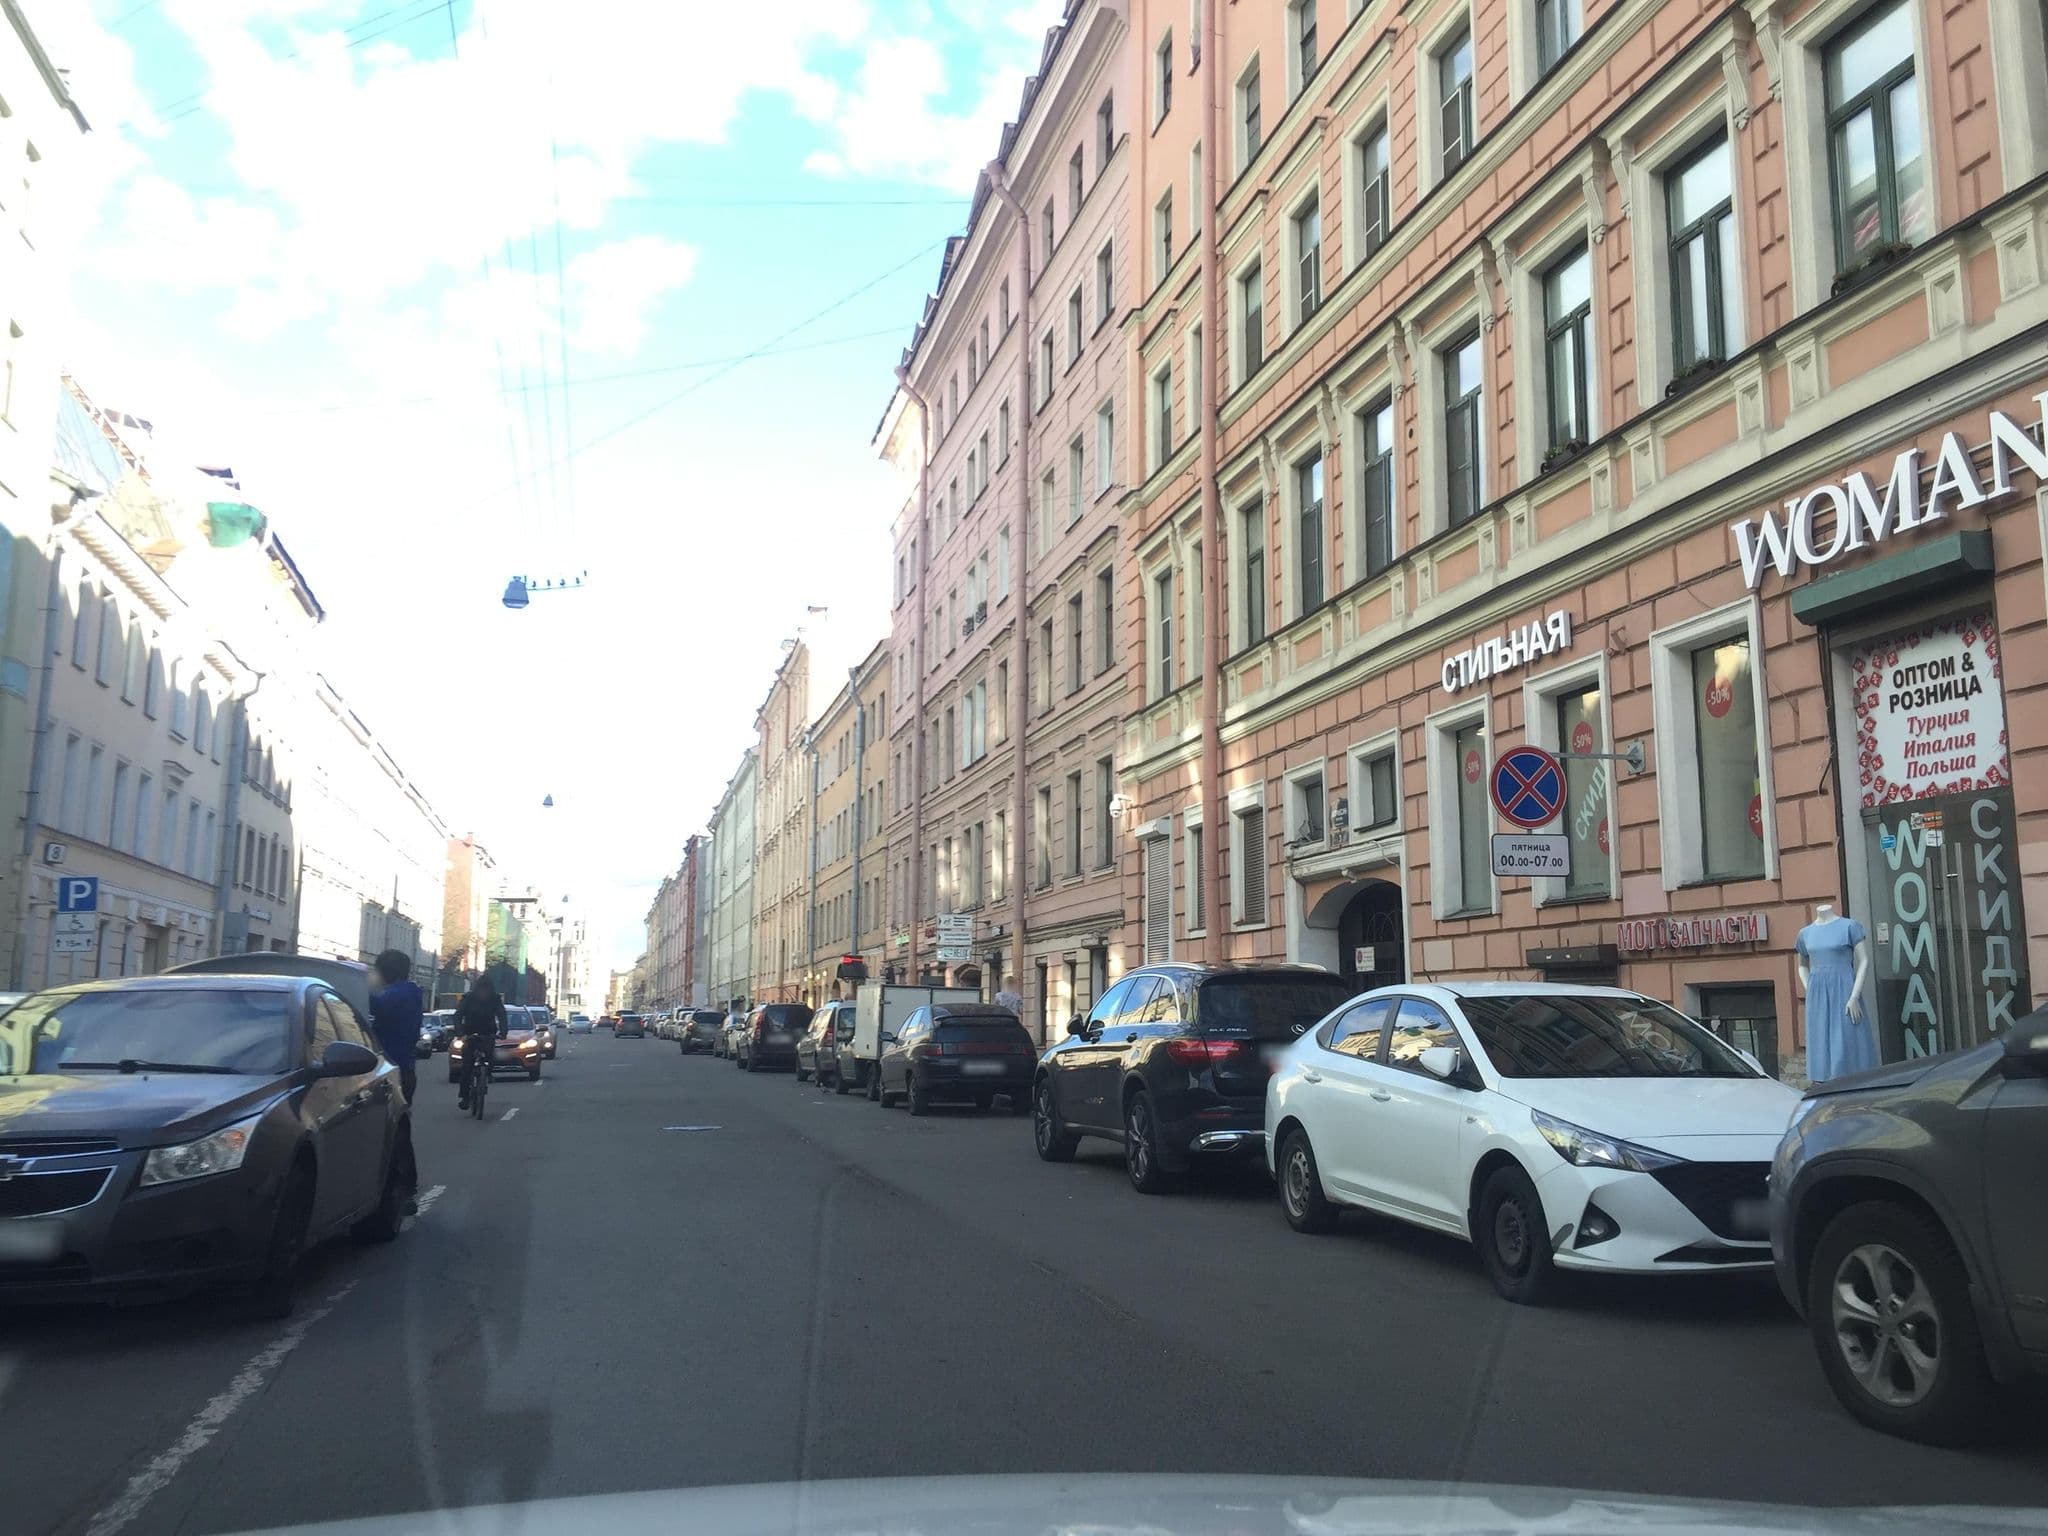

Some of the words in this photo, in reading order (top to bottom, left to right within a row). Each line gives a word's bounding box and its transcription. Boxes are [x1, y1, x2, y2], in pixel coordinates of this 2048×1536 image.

[1442, 609, 1570, 694] СТИЛЬНАЯ
[1893, 656, 1955, 689] ОПТОМ
[1961, 651, 1975, 673] &
[1707, 687, 1730, 705] -50%
[1889, 675, 1982, 713] РОЗНИЦА
[1906, 709, 1970, 737] Турция
[1904, 732, 1976, 758] Италия
[1906, 754, 1977, 779] Польша
[1511, 844, 1551, 852] пятница
[68, 880, 92, 909] P
